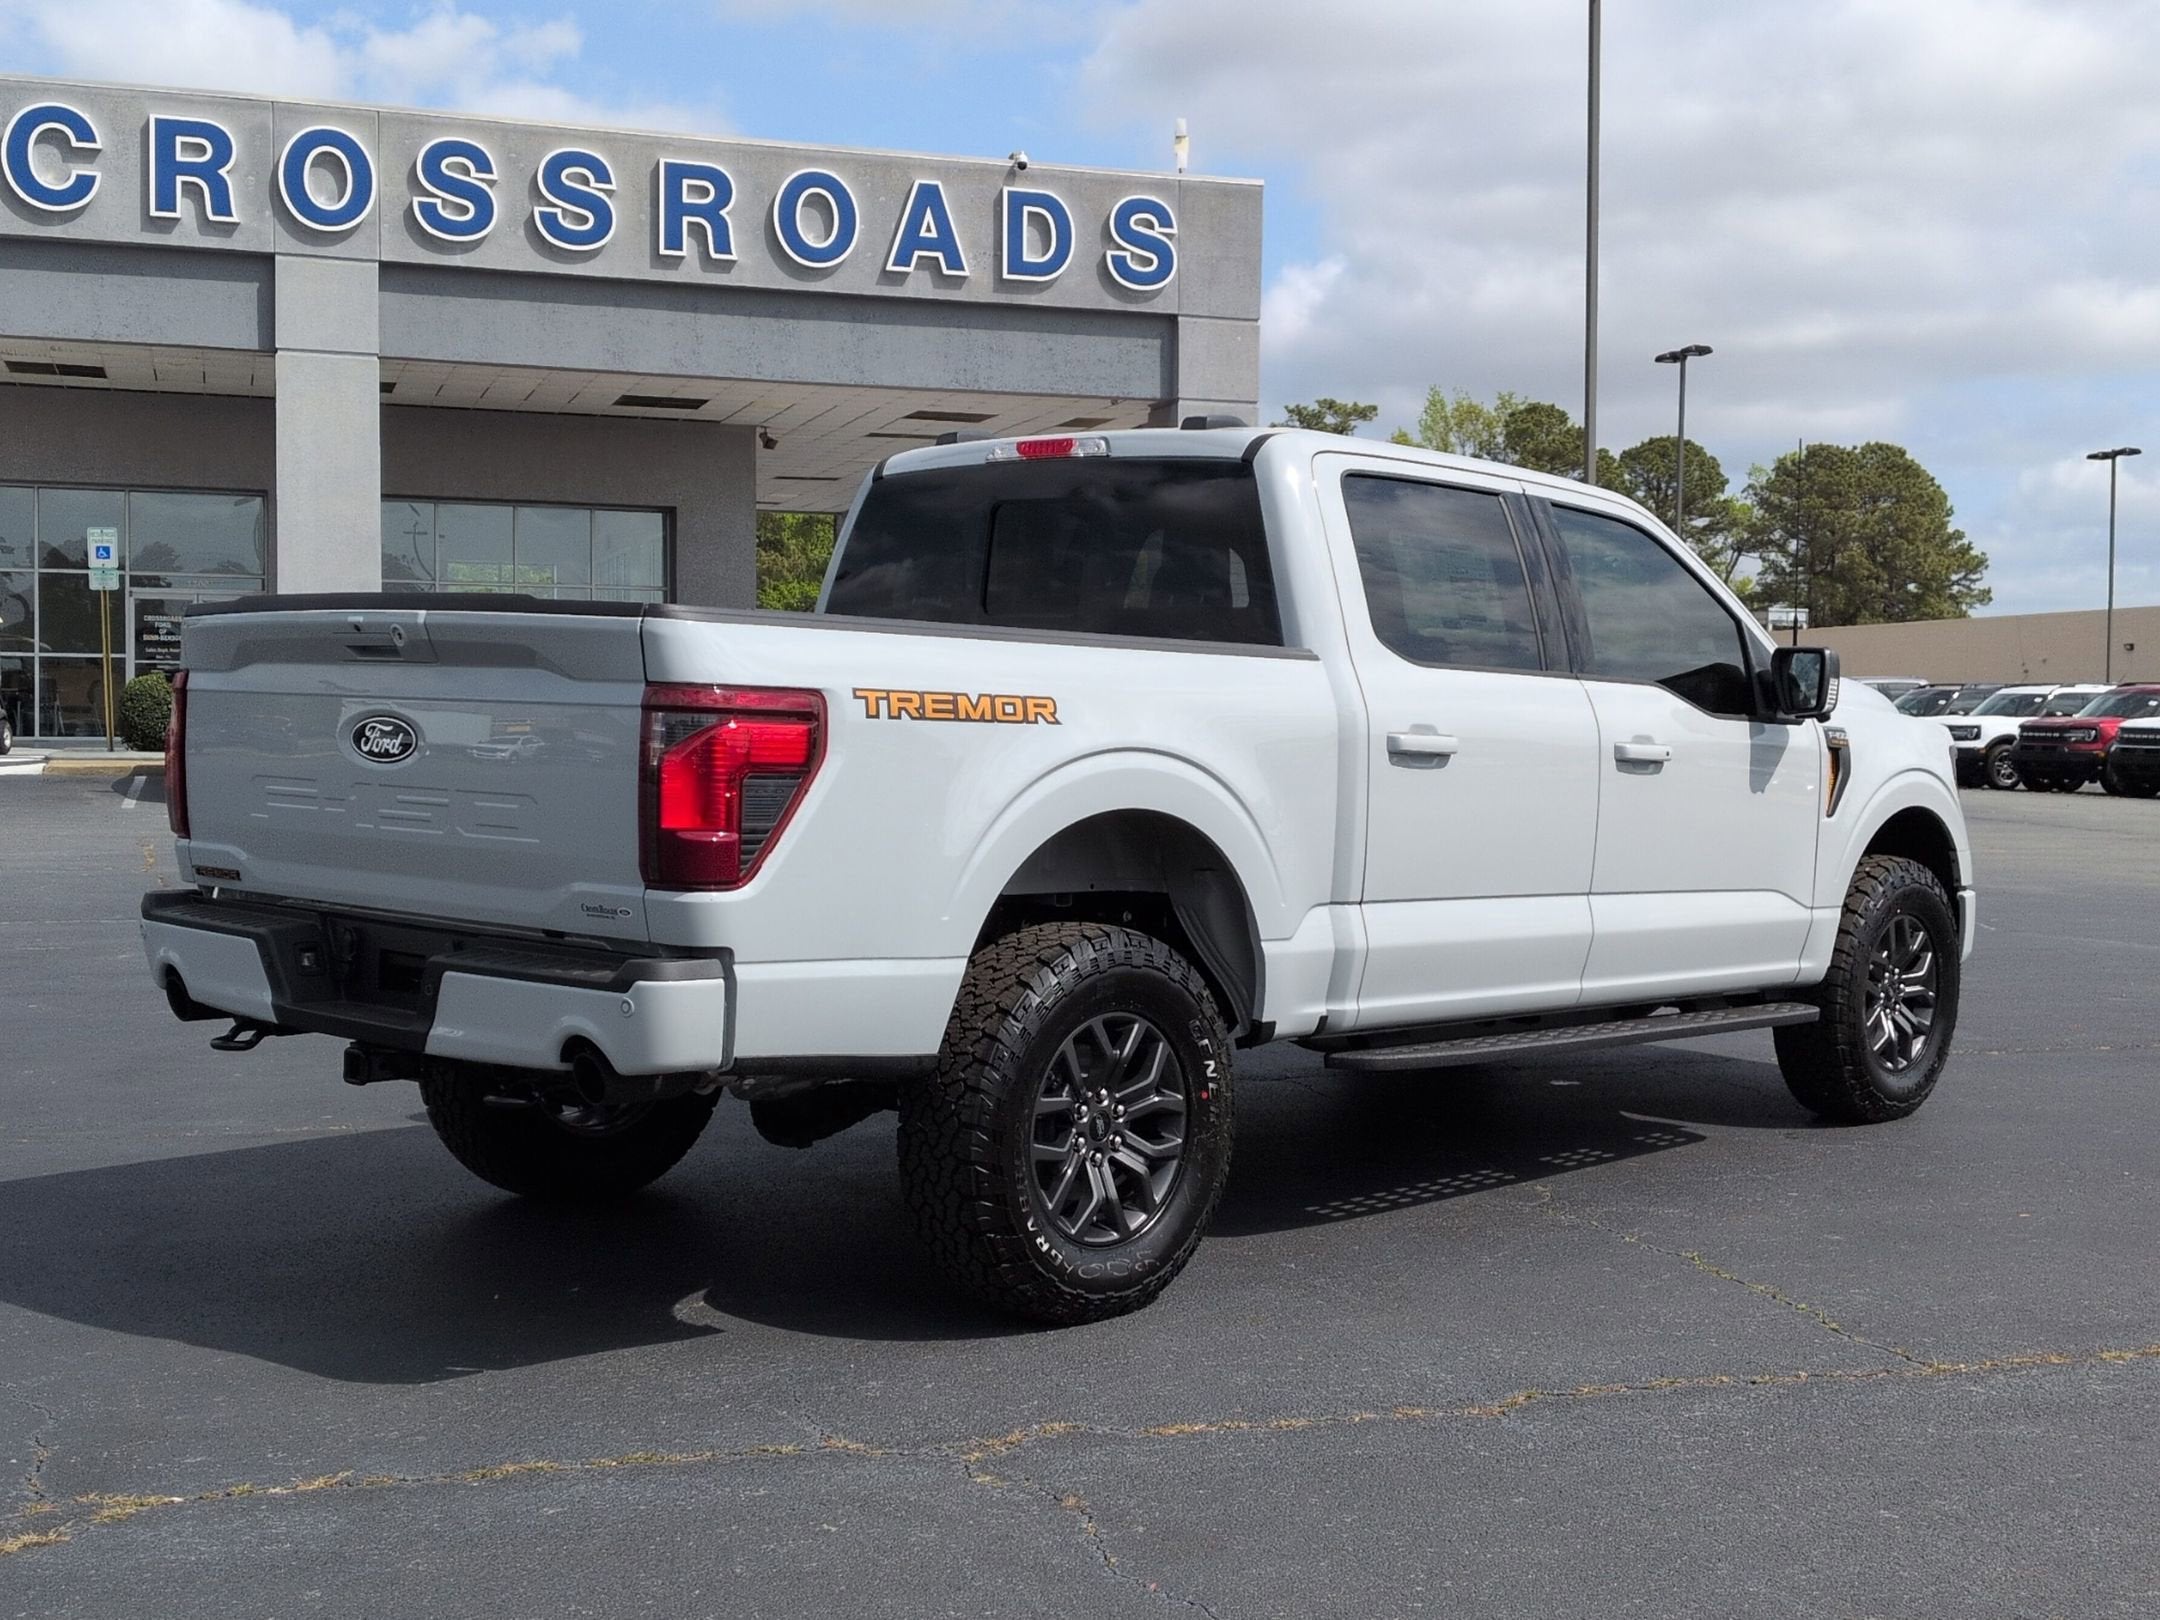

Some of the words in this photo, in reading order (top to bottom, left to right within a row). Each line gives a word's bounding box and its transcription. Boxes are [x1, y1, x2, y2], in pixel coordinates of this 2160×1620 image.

[1, 103, 1178, 291] CROSSROADS
[851, 687, 1063, 725] TREMOR
[361, 722, 404, 754] Ford
